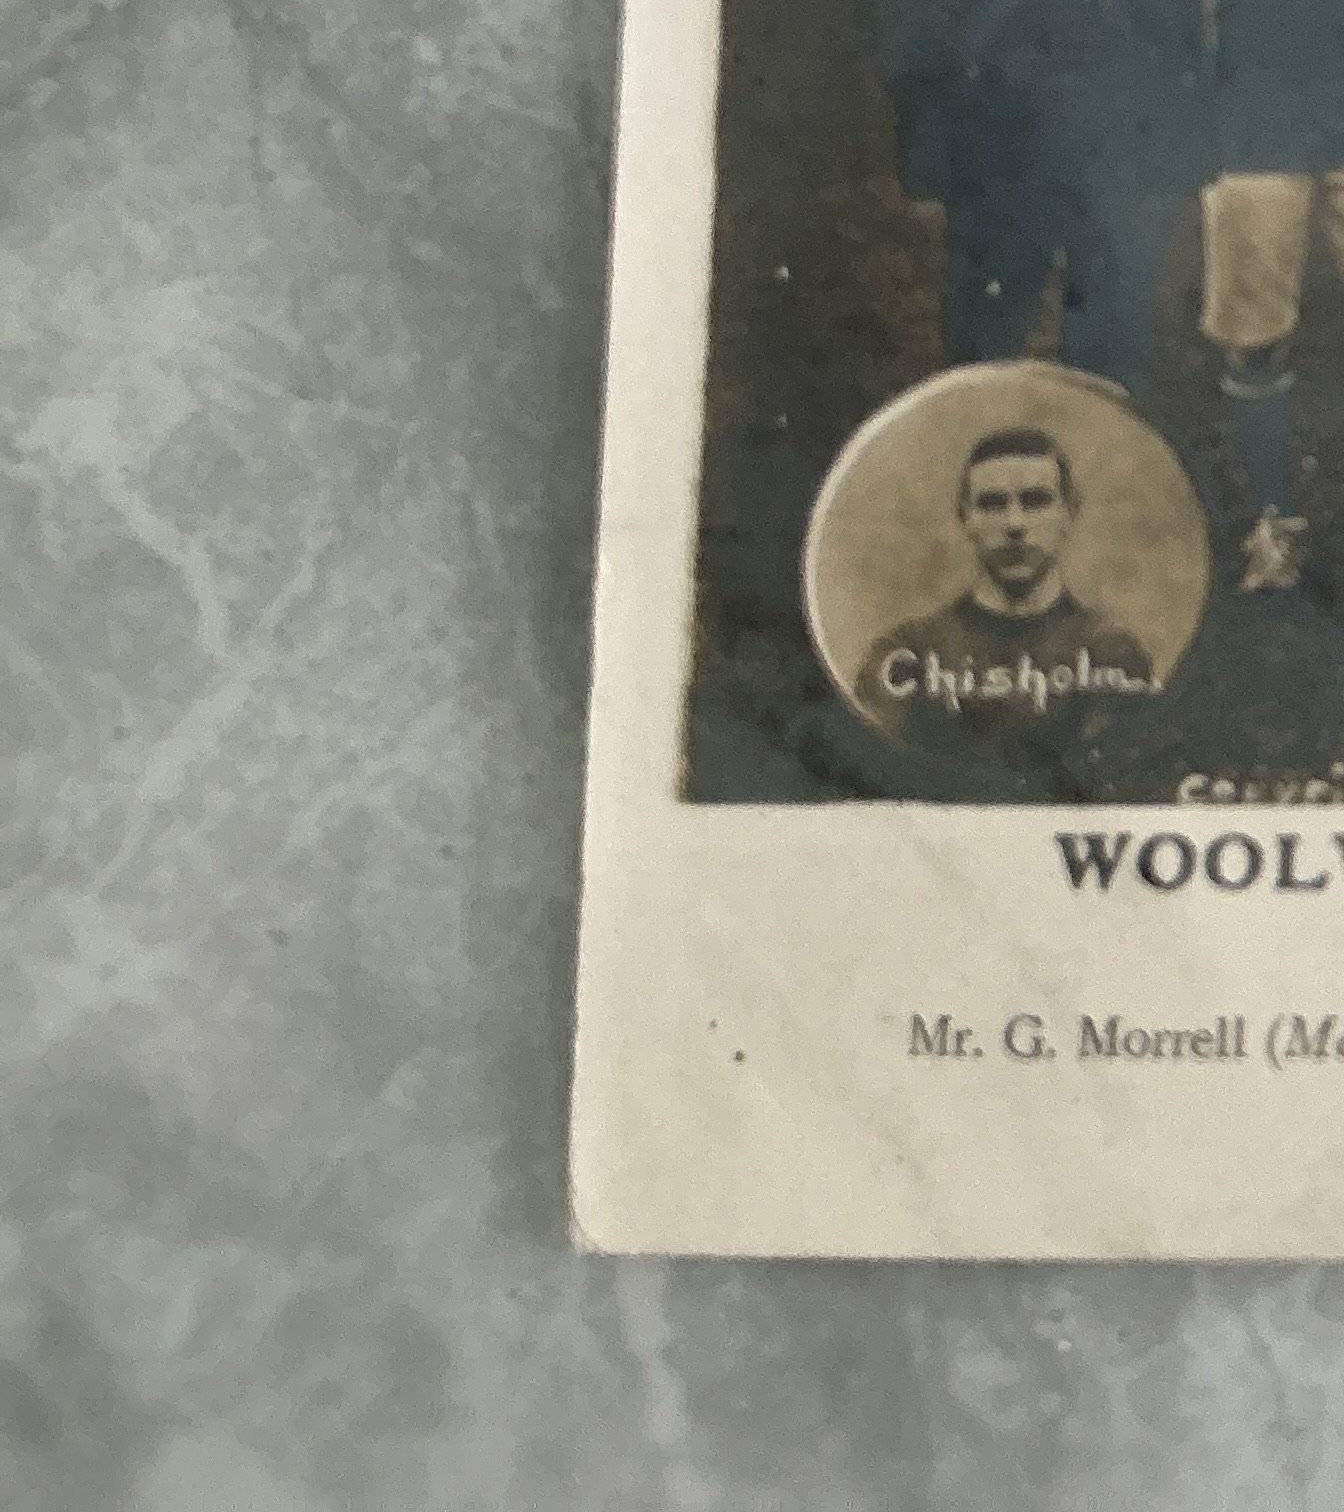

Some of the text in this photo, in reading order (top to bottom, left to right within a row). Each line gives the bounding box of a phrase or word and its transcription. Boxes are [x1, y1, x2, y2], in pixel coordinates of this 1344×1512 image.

[908, 1013, 984, 1059] Mr.
[1001, 1013, 1056, 1063] G.
[1077, 1014, 1248, 1062] Morrell
